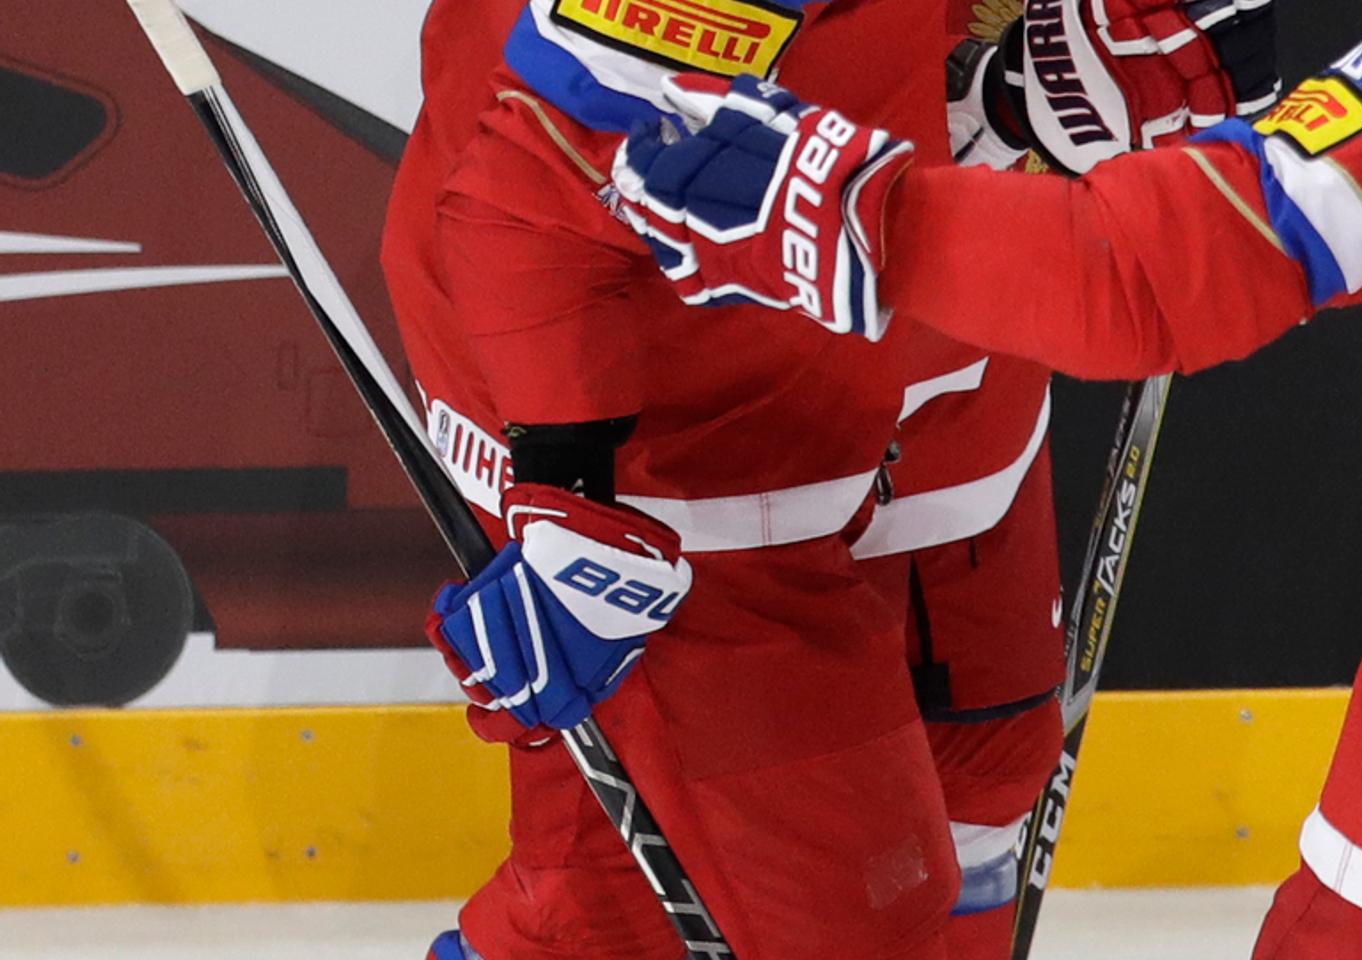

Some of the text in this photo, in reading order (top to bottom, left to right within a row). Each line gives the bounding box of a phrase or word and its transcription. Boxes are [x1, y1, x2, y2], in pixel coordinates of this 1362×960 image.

[1080, 596, 1107, 672] SUPER
[1096, 480, 1137, 596] TACKS
[1028, 750, 1077, 890] CCM
